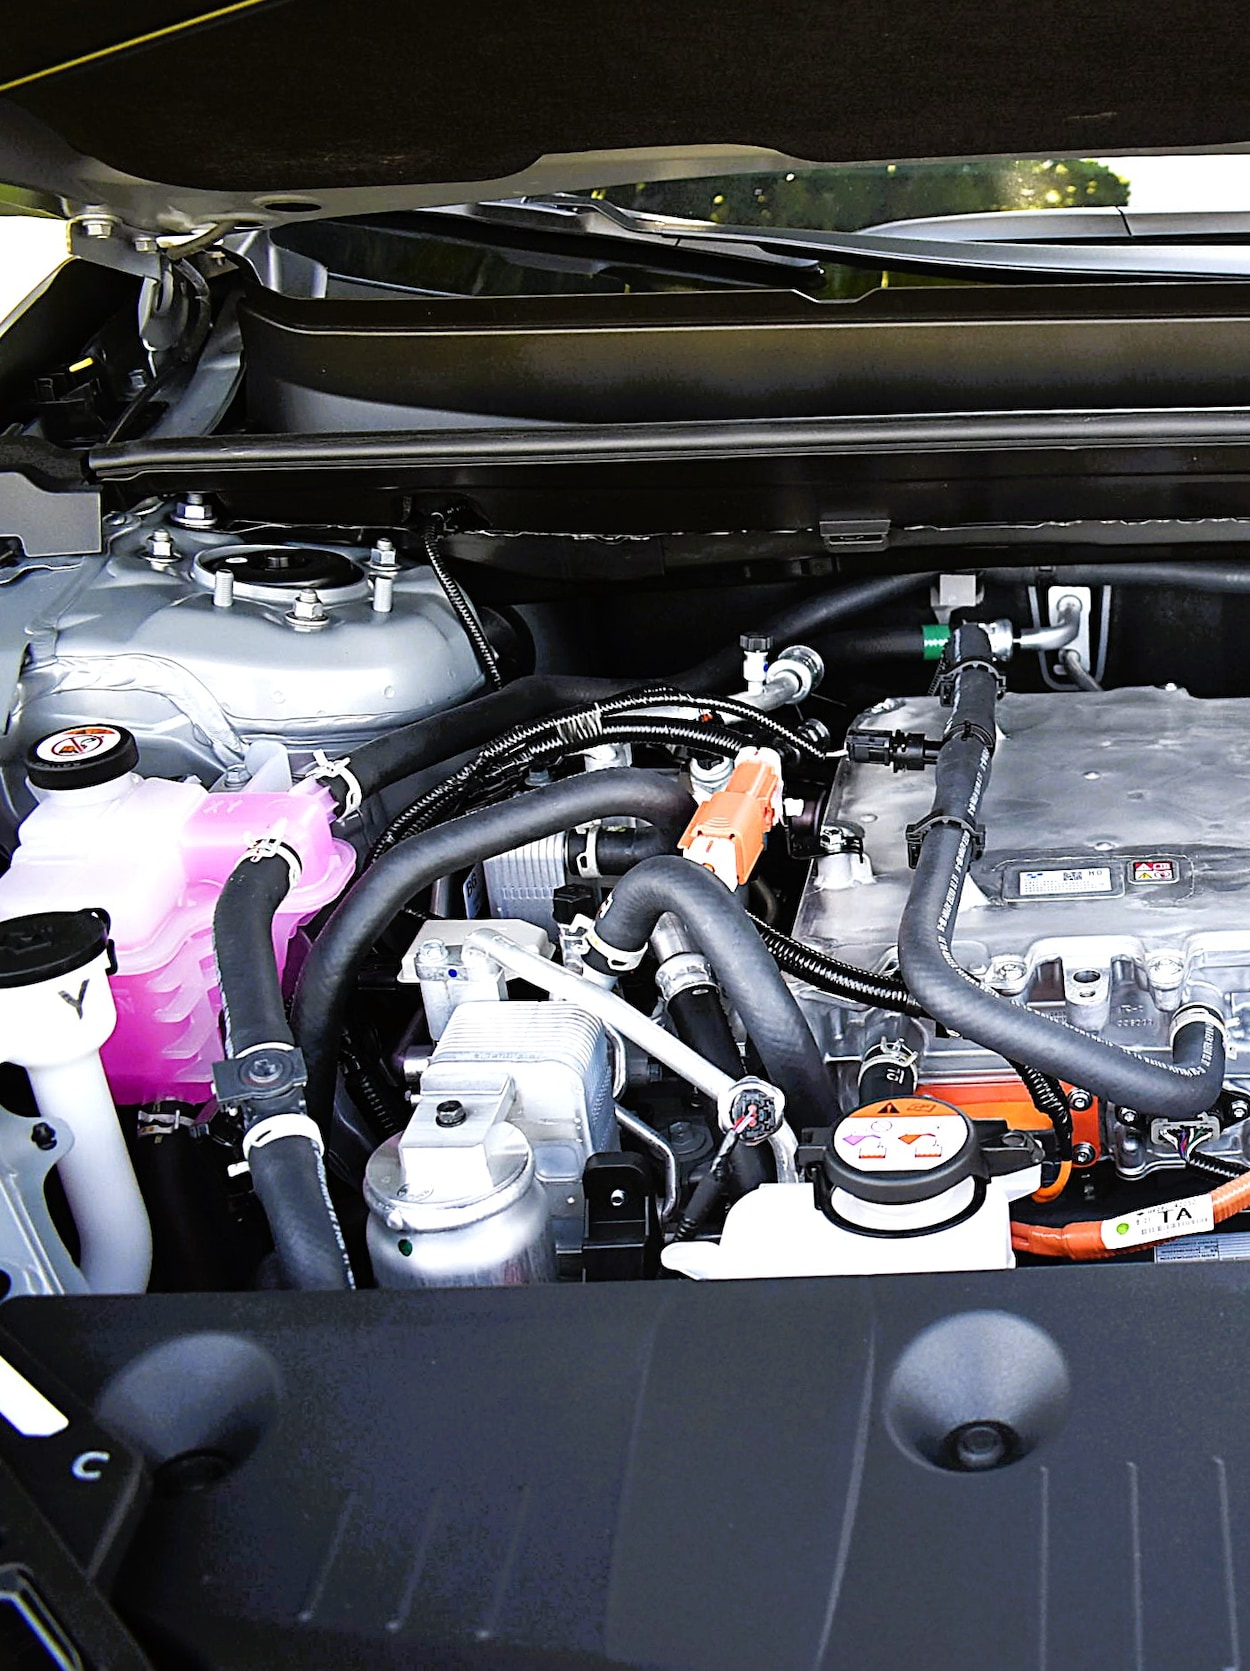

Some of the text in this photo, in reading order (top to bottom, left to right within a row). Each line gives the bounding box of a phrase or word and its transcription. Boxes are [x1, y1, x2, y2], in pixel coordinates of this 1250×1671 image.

[58, 979, 90, 1019] Y
[1158, 1207, 1193, 1223] TA
[71, 1451, 110, 1480] C
